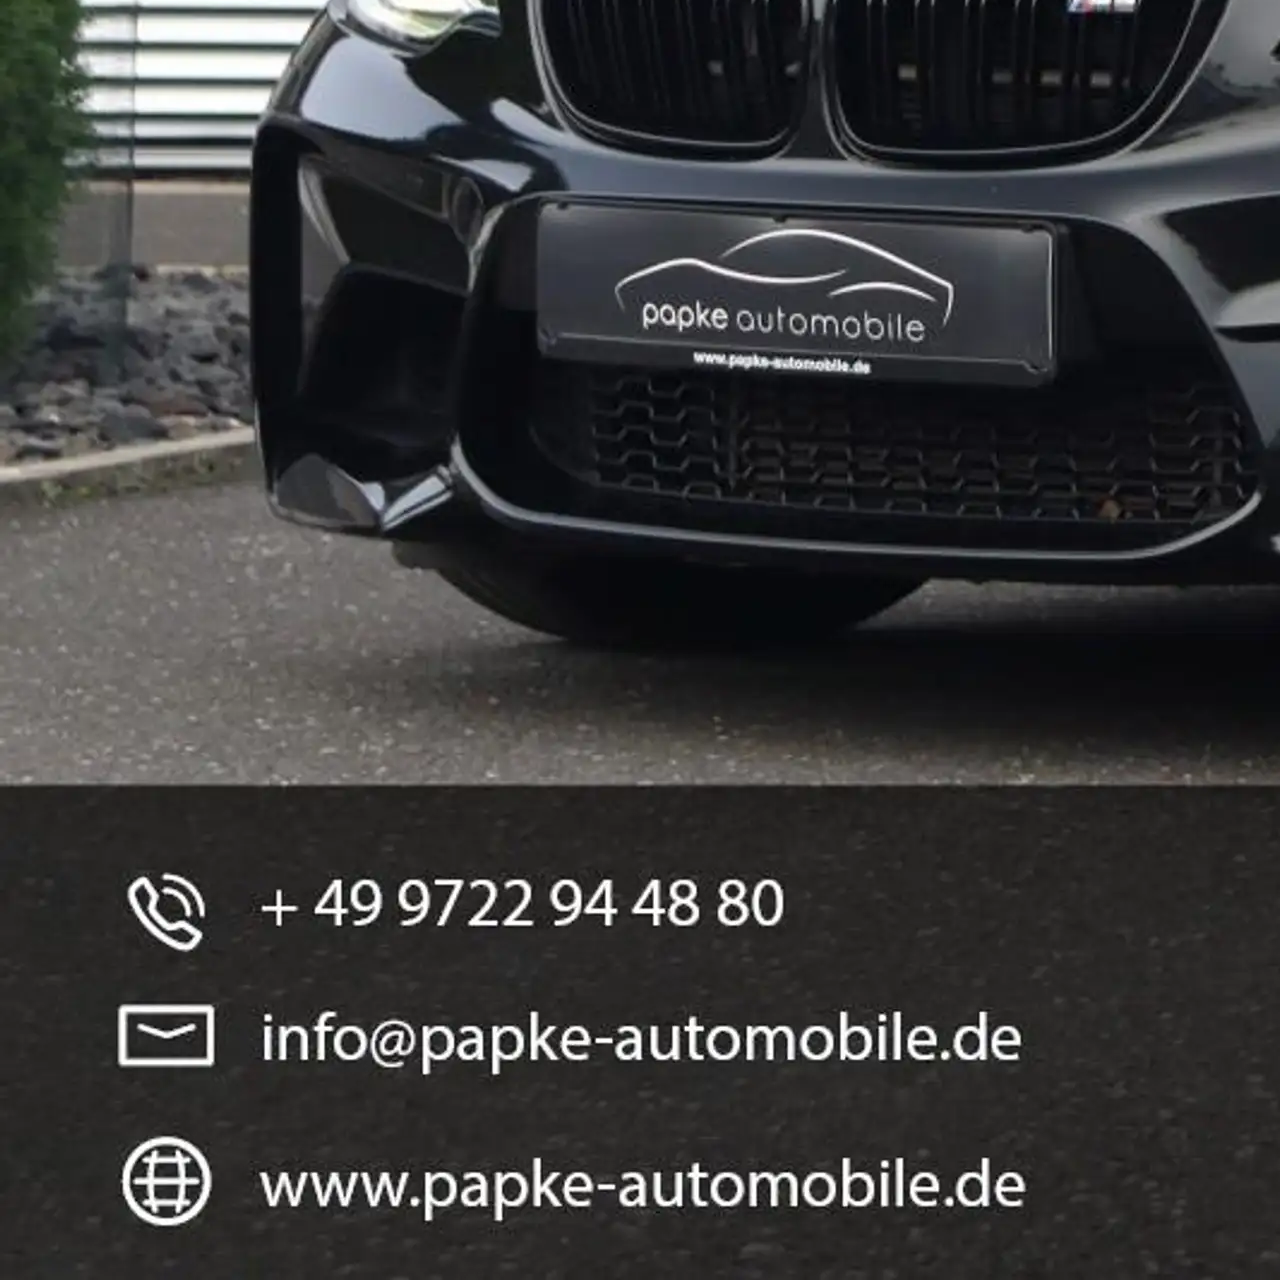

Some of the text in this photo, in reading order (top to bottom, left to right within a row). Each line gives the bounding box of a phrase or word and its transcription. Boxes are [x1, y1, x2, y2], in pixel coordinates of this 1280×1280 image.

[642, 298, 926, 343] papke automobile
[692, 350, 872, 376] www.papke-automobile.de
